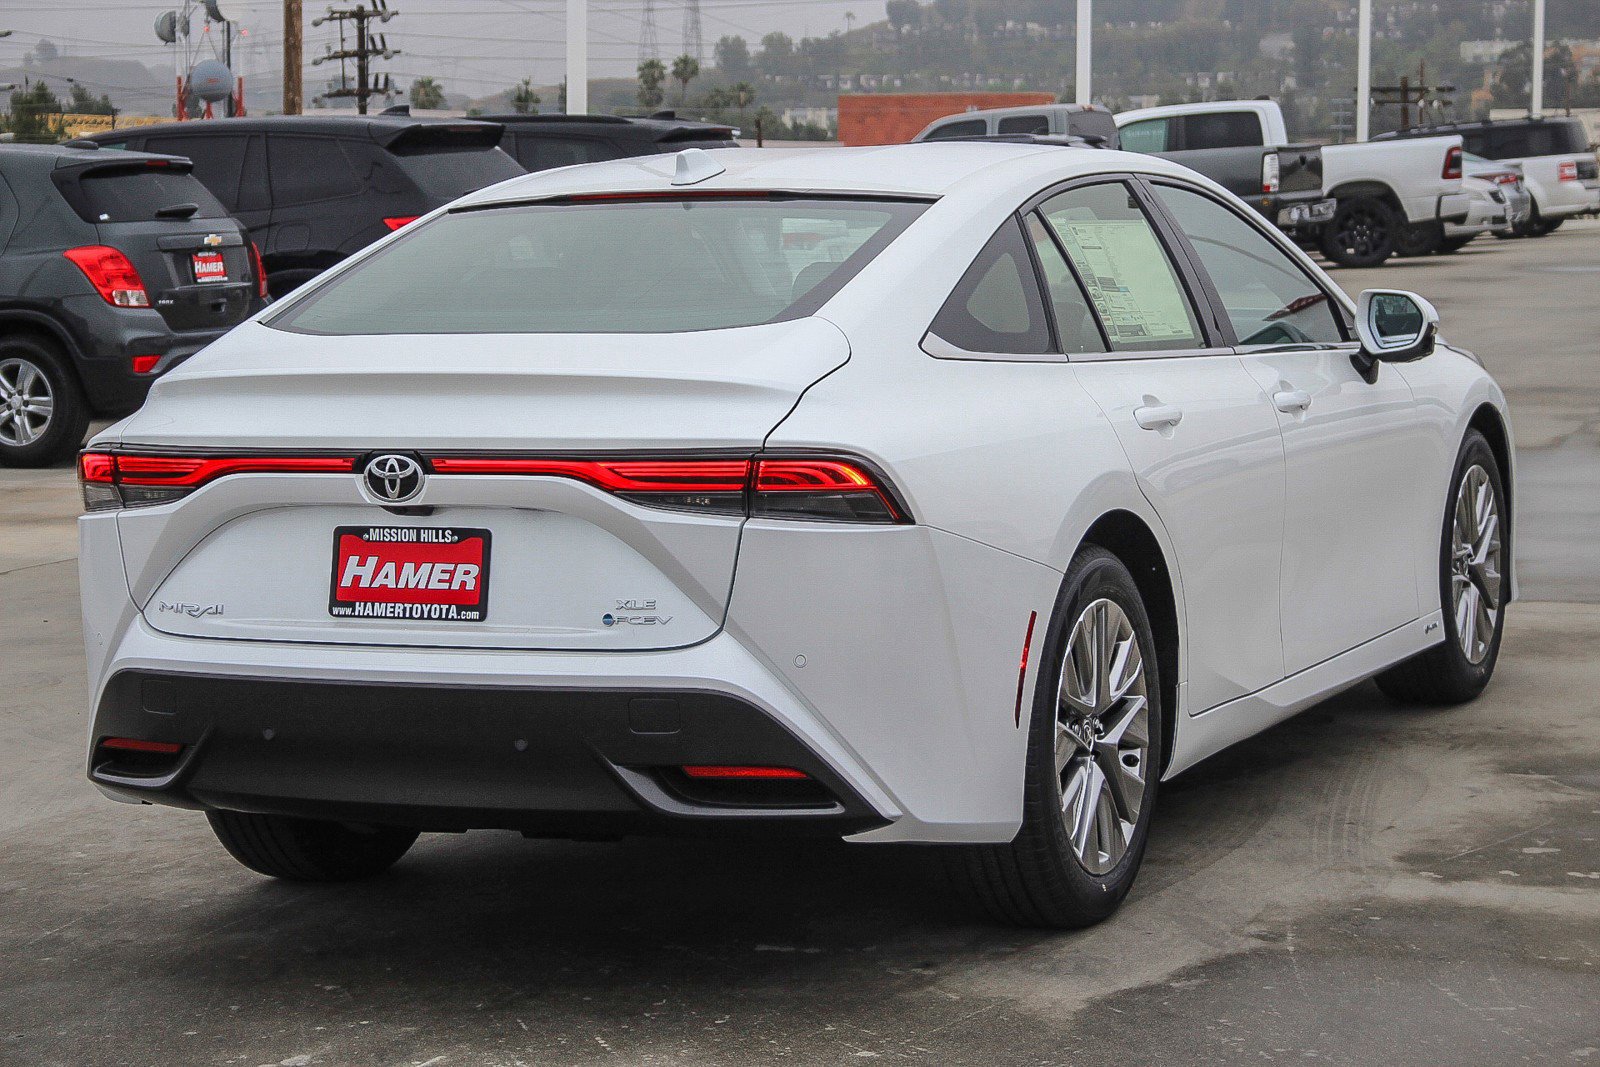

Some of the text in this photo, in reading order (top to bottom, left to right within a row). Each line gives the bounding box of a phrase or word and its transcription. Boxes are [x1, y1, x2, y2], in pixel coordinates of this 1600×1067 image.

[194, 261, 224, 274] HAMER
[369, 528, 453, 543] MISSION HILLS
[340, 555, 480, 590] HAMER
[159, 600, 224, 618] MIRAI
[332, 601, 480, 620] www.HAMERTOYOTA.com
[615, 599, 657, 611] XLE
[615, 615, 674, 626] FCEV
